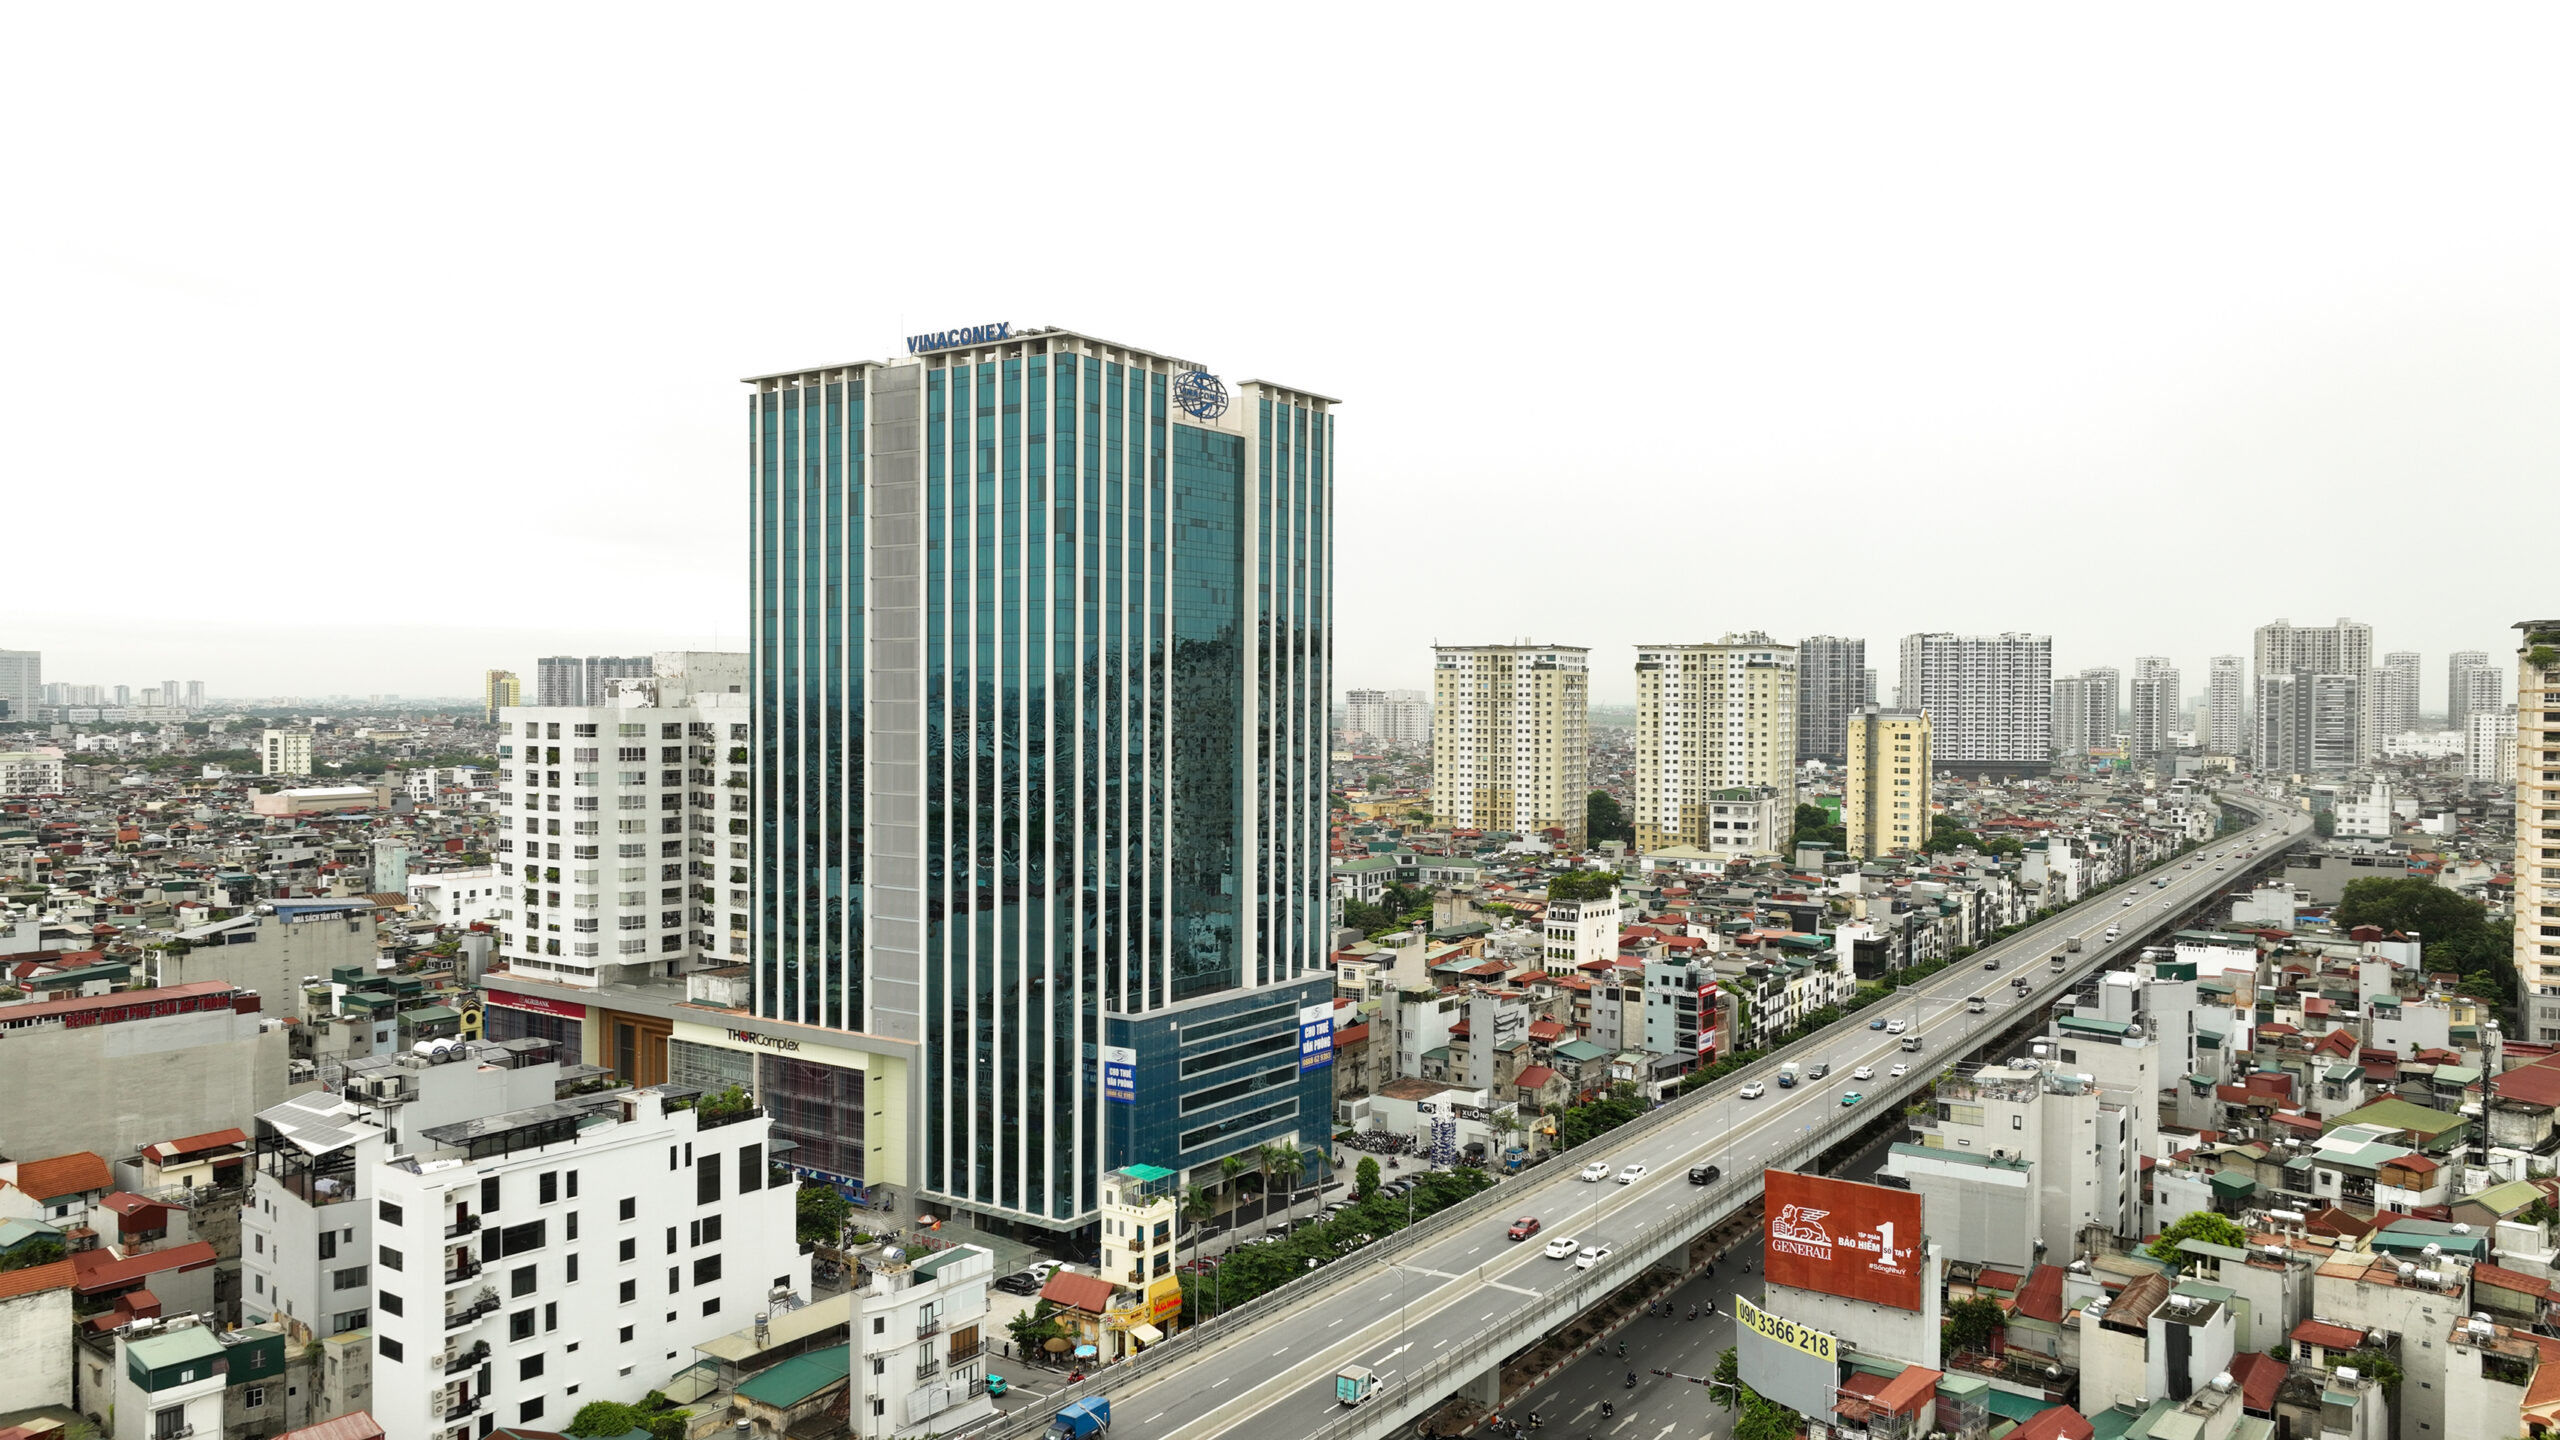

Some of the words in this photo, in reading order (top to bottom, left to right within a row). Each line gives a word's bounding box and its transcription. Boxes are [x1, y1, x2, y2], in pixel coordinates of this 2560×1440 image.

[906, 321, 1009, 354] VINACONEX
[305, 912, 320, 922] SÁCH
[524, 998, 550, 1008] AGRIBANK
[1772, 1239, 1832, 1261] GENERALI
[1838, 1235, 1856, 1248] BẢO
[1858, 1239, 1881, 1253] HIỂM
[1894, 1249, 1905, 1258] TẠI
[1905, 1247, 1912, 1258] Ý
[1876, 1221, 1898, 1267] 1
[1740, 1302, 1756, 1327] 090
[1758, 1314, 1795, 1343] 3366
[1800, 1330, 1829, 1356] 218
